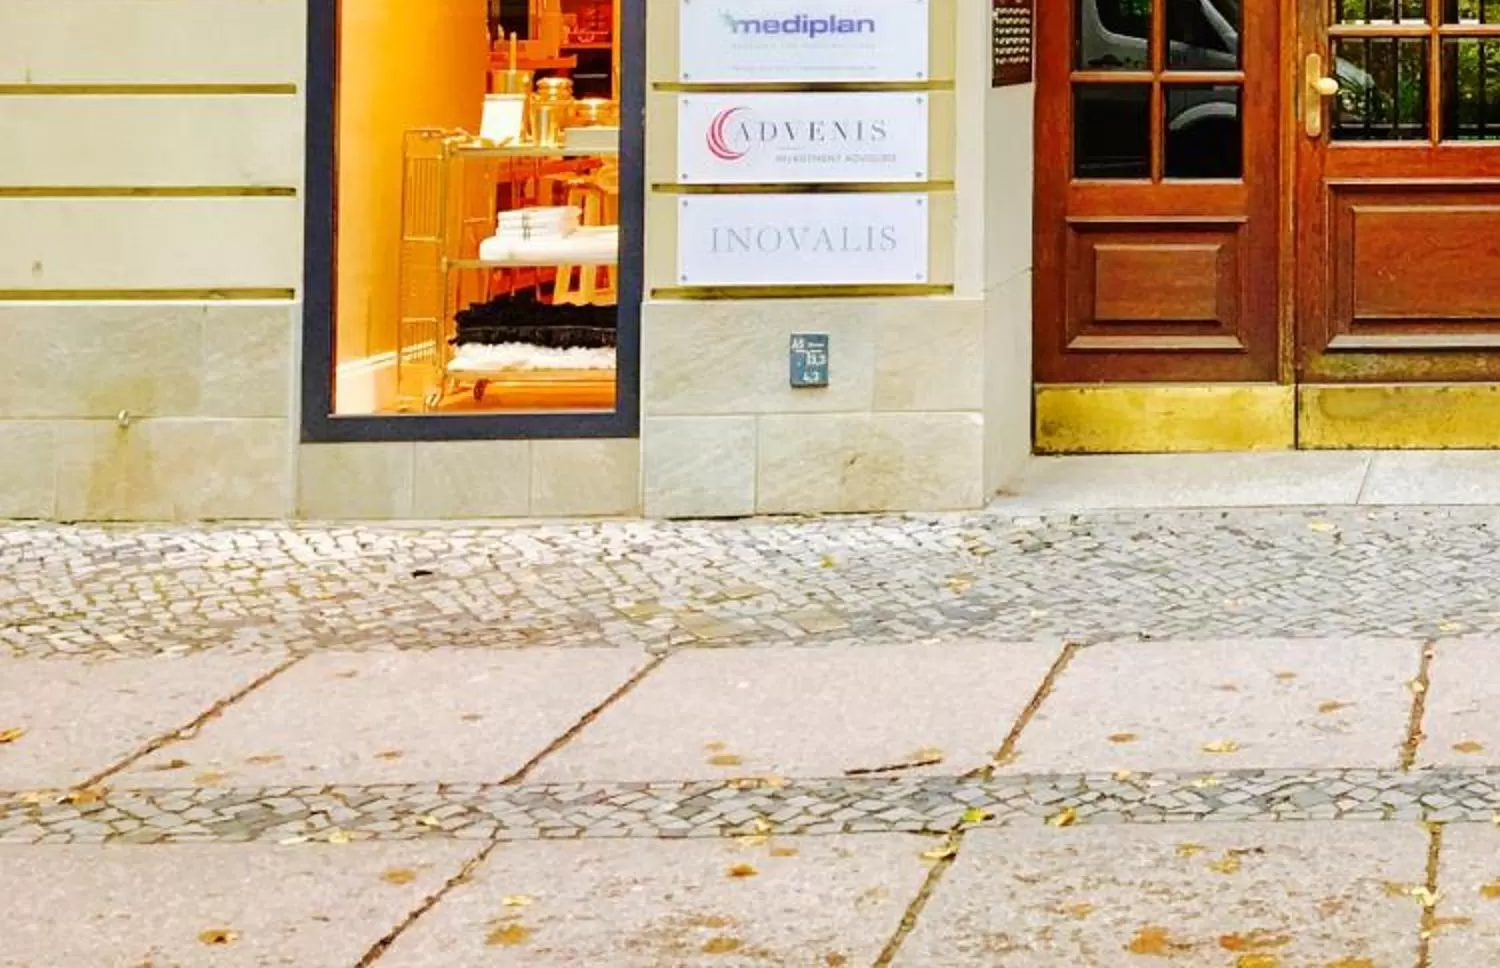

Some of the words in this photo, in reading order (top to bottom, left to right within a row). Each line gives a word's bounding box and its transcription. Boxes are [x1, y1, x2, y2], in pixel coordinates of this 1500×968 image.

[731, 14, 876, 39] mediplan
[734, 118, 888, 142] ADVENIS
[710, 225, 899, 254] INOVALIS
